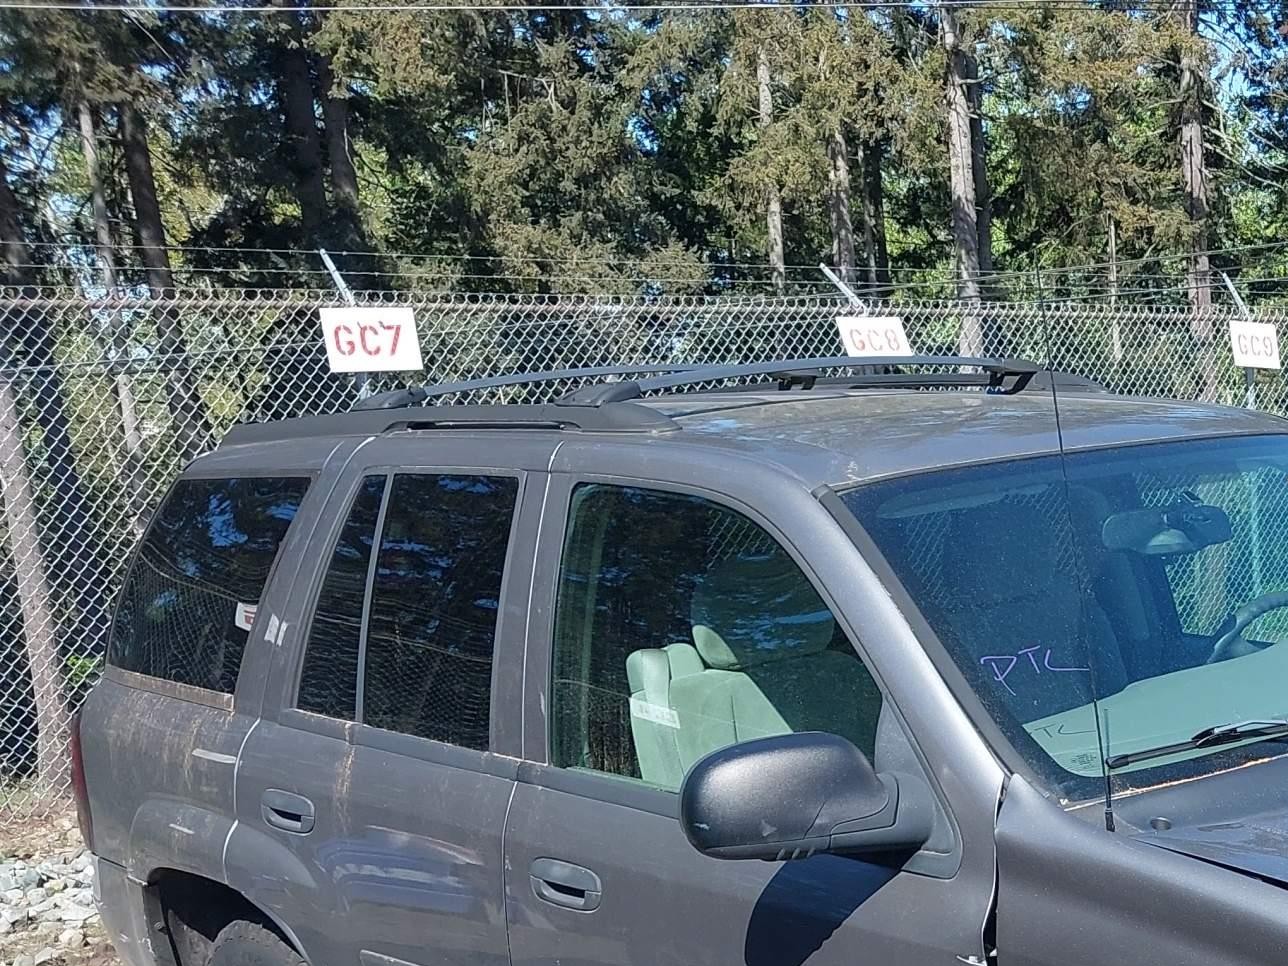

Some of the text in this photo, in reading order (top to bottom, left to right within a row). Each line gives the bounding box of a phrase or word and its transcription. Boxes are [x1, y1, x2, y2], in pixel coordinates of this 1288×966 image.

[333, 324, 401, 356] GC7
[849, 328, 900, 351] GC8
[1237, 334, 1274, 357] GC9
